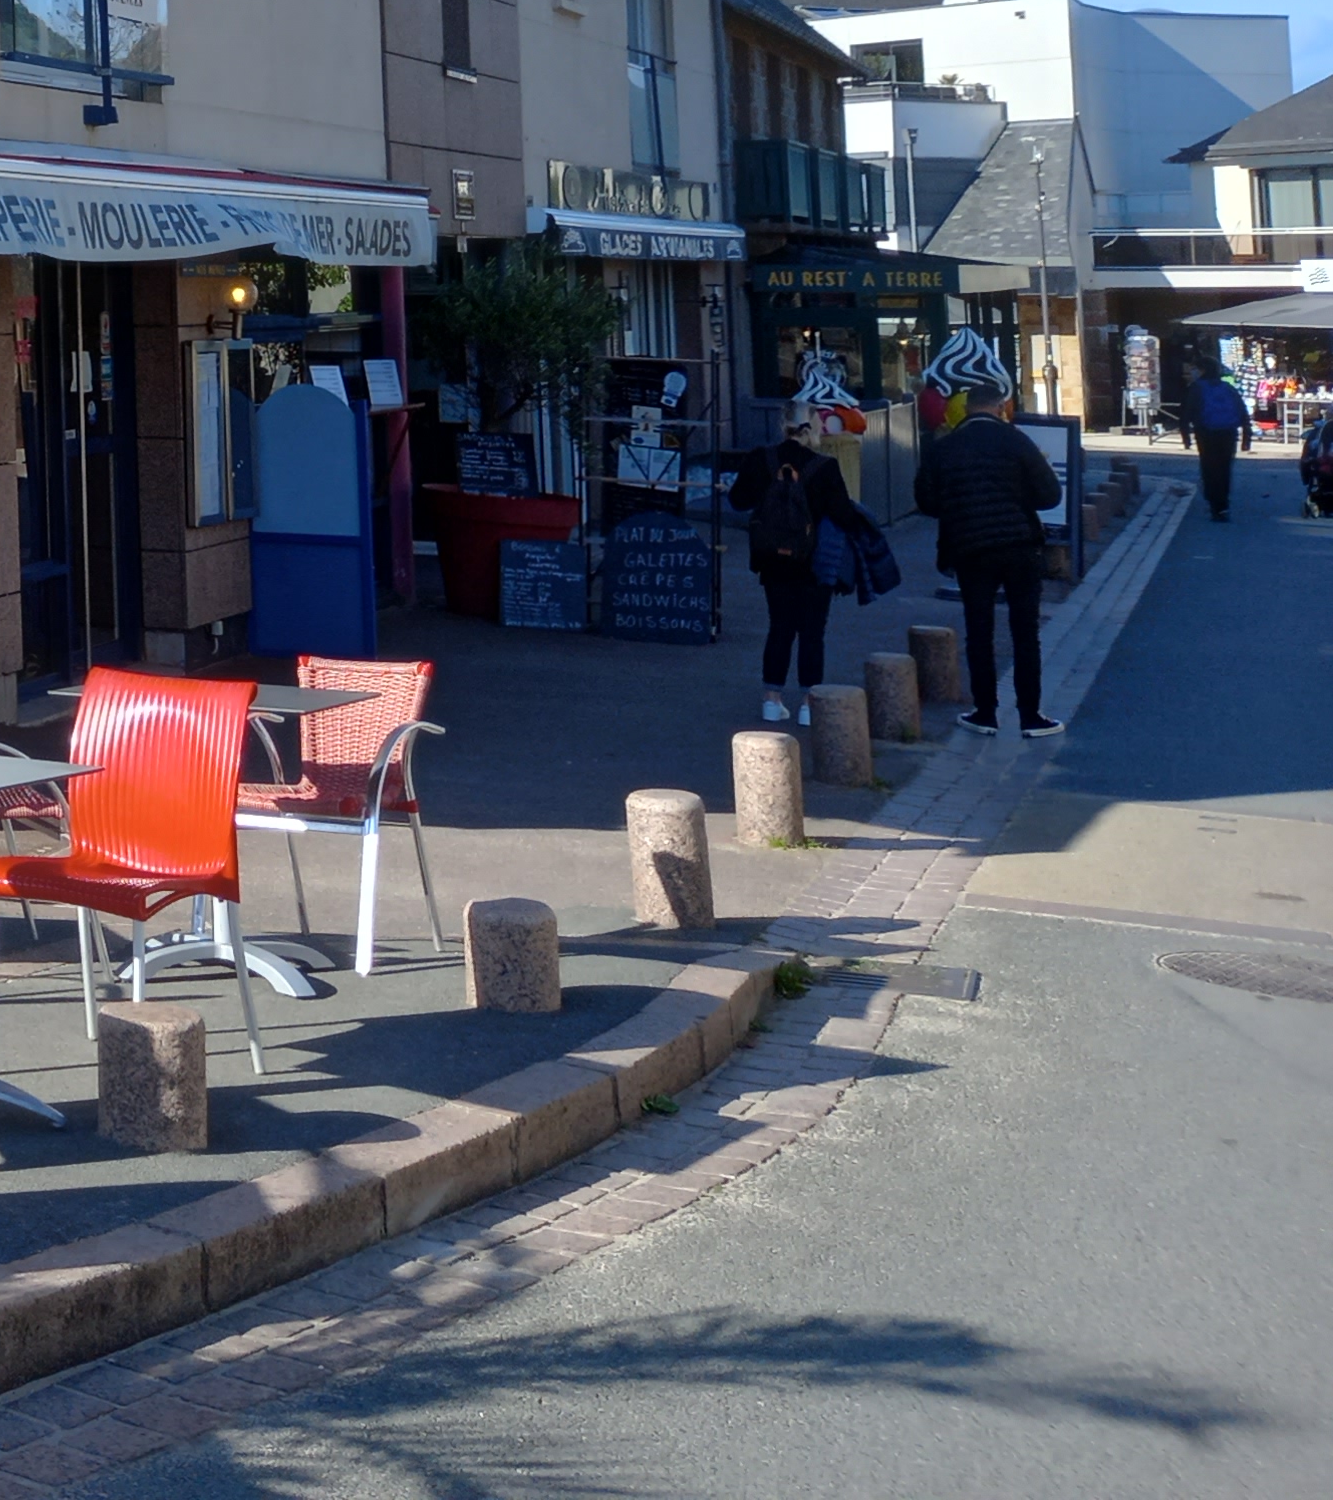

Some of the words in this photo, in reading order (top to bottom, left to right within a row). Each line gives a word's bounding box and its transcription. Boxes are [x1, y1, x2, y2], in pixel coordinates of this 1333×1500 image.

[78, 202, 220, 250] MOULERIE
[302, 215, 336, 255] MER
[345, 216, 412, 257] SALADES
[599, 232, 643, 256] GLACES
[768, 271, 793, 287] AU
[863, 272, 875, 287] A
[885, 271, 943, 287] TERRE
[615, 526, 645, 543] PLAT
[624, 552, 708, 569] GALETTES
[616, 613, 704, 632] BOISSONS
